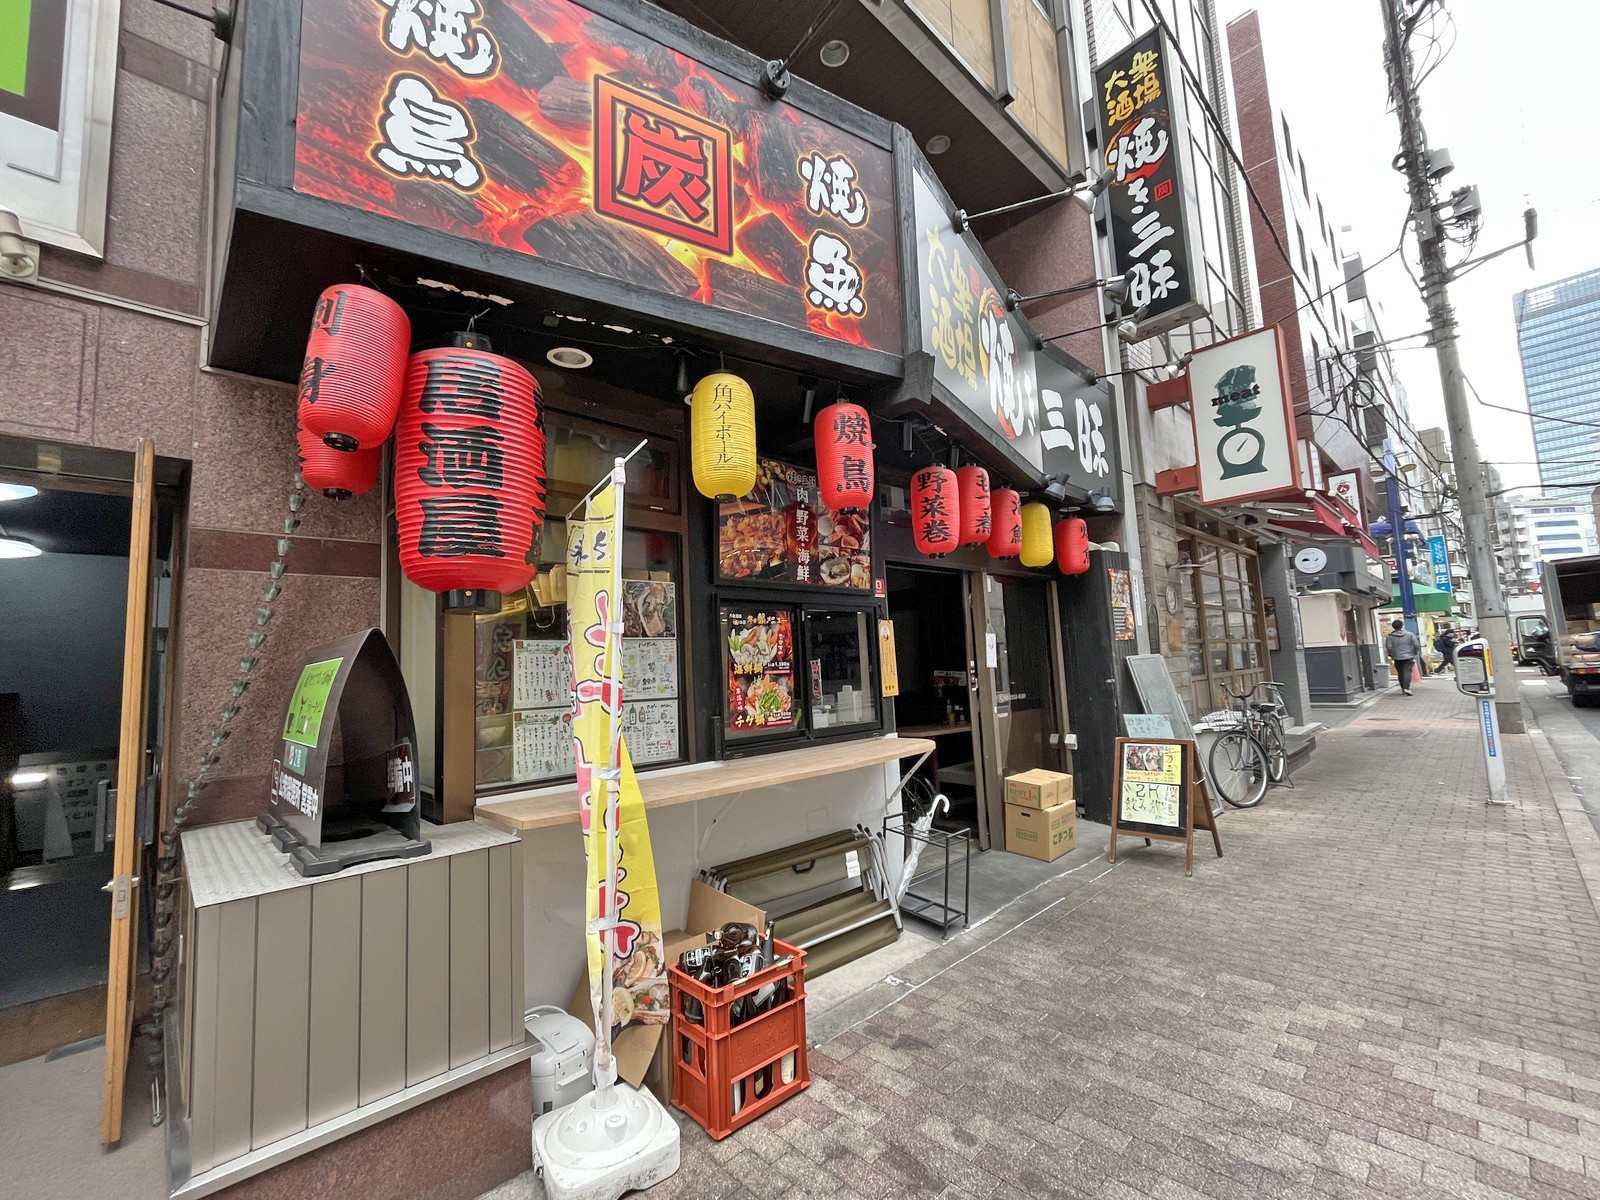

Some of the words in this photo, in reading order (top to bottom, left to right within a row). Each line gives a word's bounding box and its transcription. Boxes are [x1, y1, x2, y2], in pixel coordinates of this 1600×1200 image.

[379, 0, 496, 188] 焼鳥
[616, 112, 710, 223] 炭
[801, 155, 866, 314] 焼魚
[713, 383, 733, 465] 角ハイボール
[1211, 382, 1261, 407] meat
[418, 355, 506, 558] 居酒屋
[834, 411, 869, 493] 焼鳥
[796, 488, 810, 581] 肉・野菜・海鮮
[916, 470, 951, 543] 野菜巻
